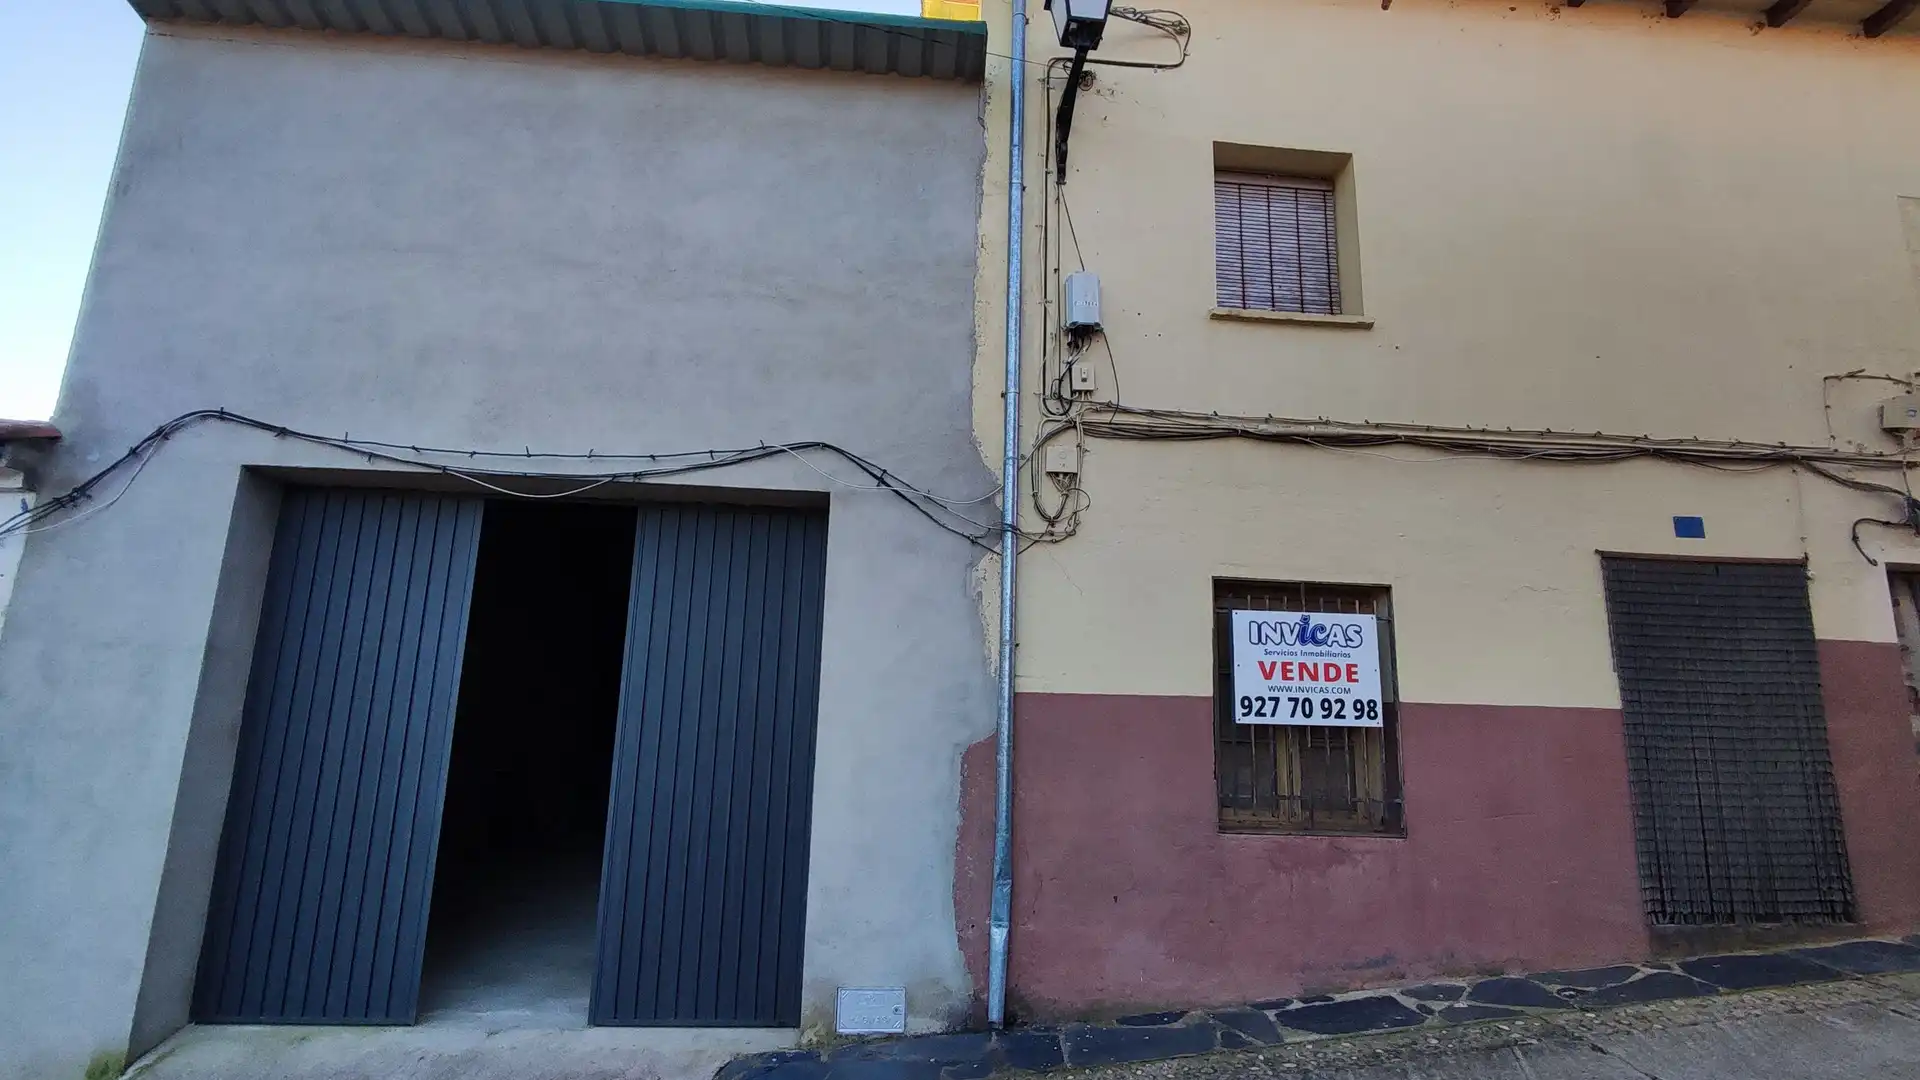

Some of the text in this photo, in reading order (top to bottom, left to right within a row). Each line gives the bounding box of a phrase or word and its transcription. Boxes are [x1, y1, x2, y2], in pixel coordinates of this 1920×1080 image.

[1264, 648, 1351, 658] Servicios Inmobiliarios
[1257, 661, 1359, 683] VENDE
[1268, 685, 1351, 694] WWW.INVICAS.COM
[1240, 696, 1378, 720] 927 70 92 98
